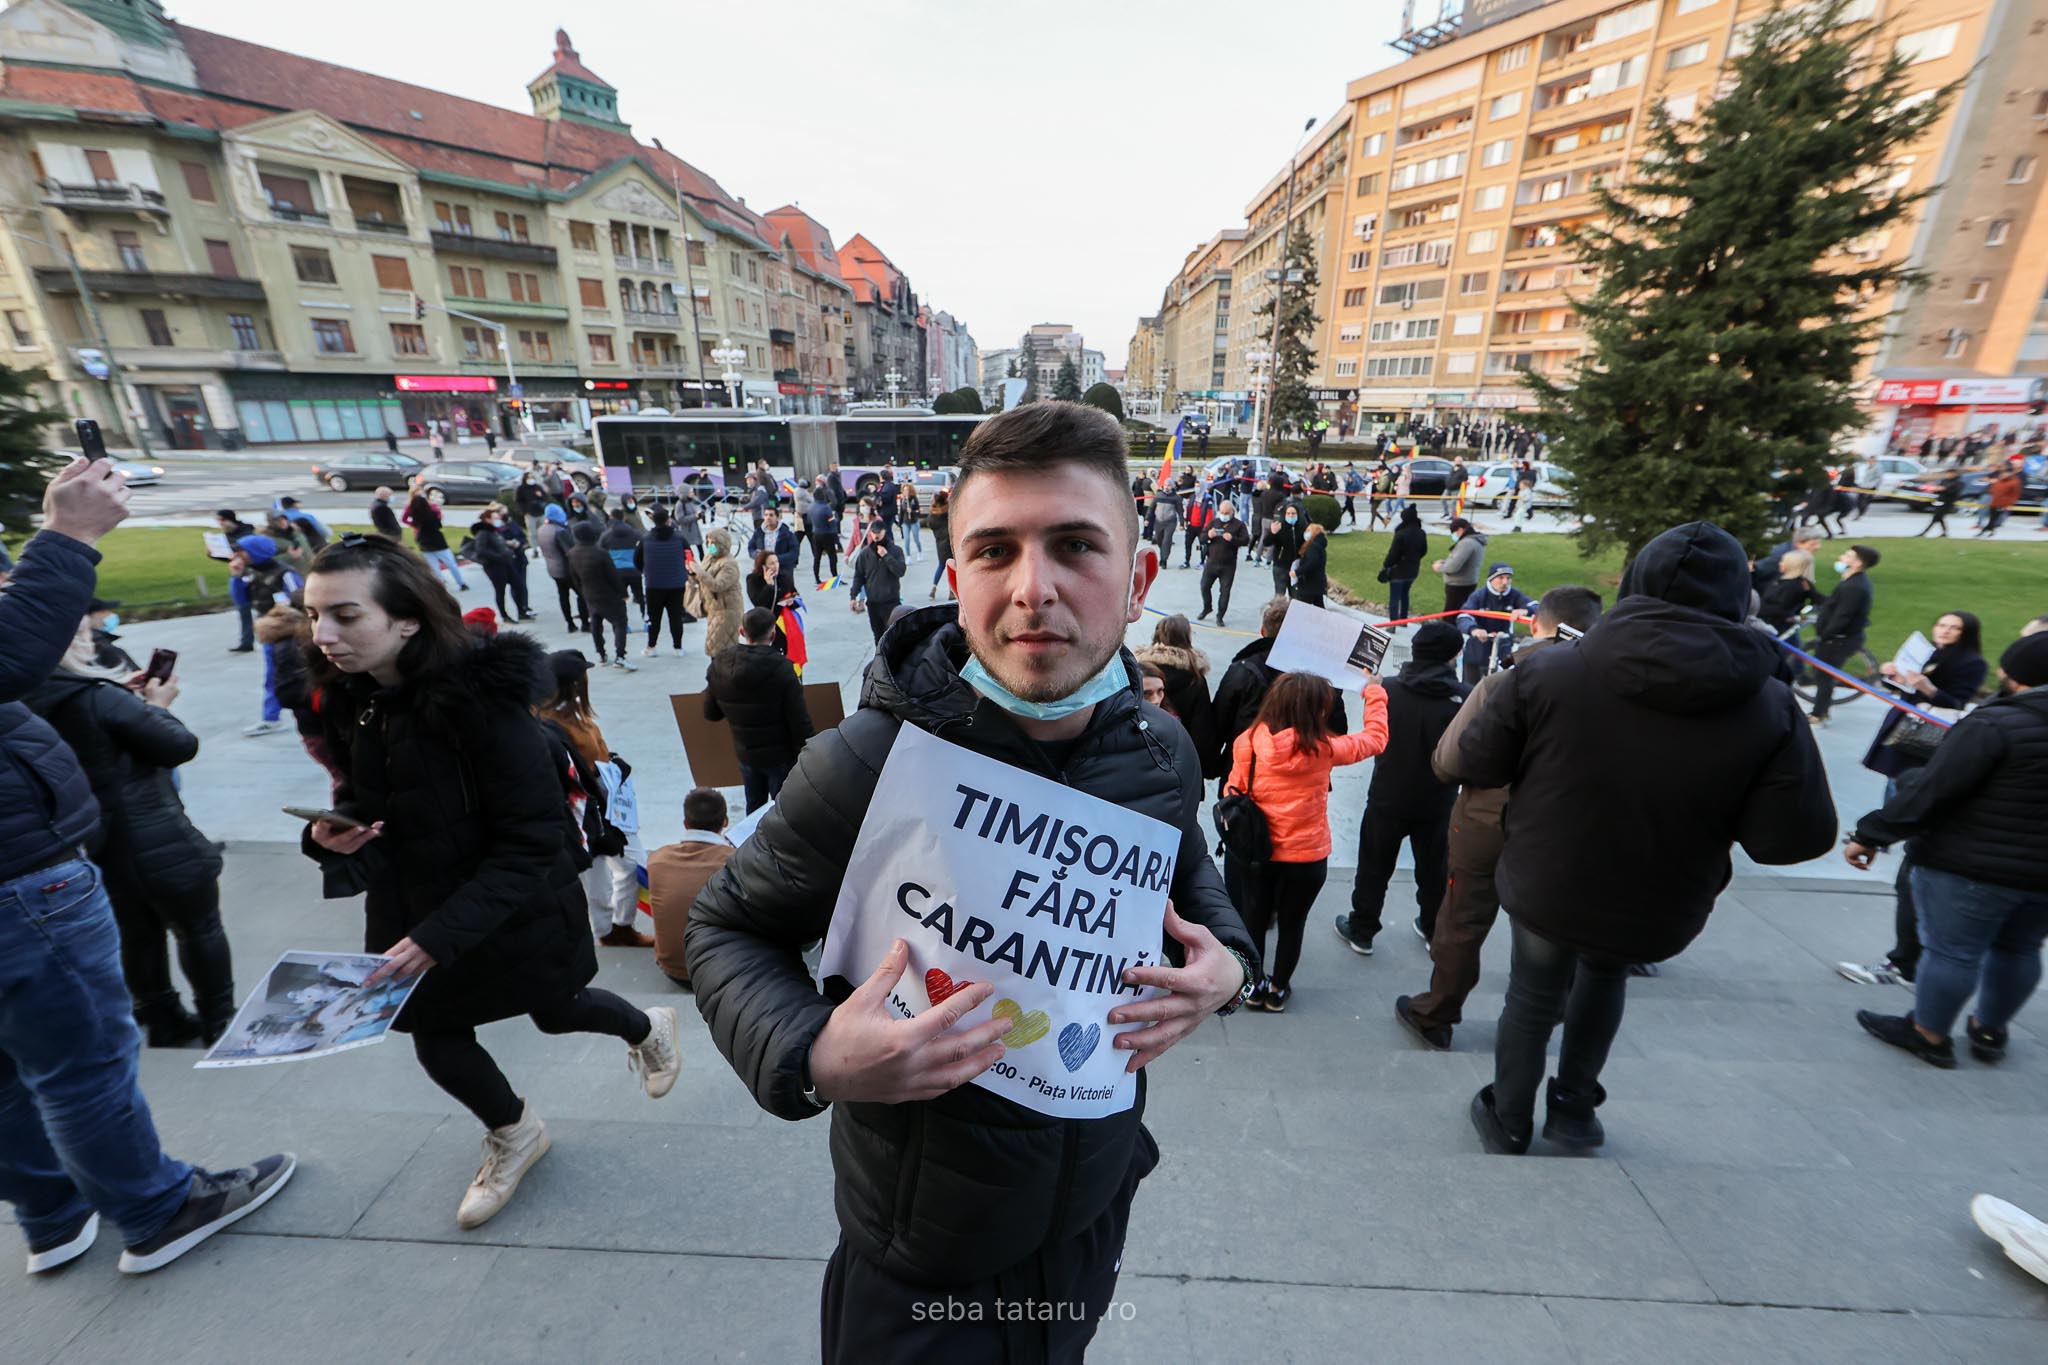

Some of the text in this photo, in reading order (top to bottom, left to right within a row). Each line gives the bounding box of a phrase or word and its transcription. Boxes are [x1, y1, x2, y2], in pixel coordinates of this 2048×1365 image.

[953, 784, 1172, 894] TIMIȘOARA
[1001, 870, 1122, 939] FĂRĂ
[892, 994, 916, 1019] Ma
[1028, 1076, 1066, 1101] Piața
[1070, 1085, 1115, 1101] Victoriei
